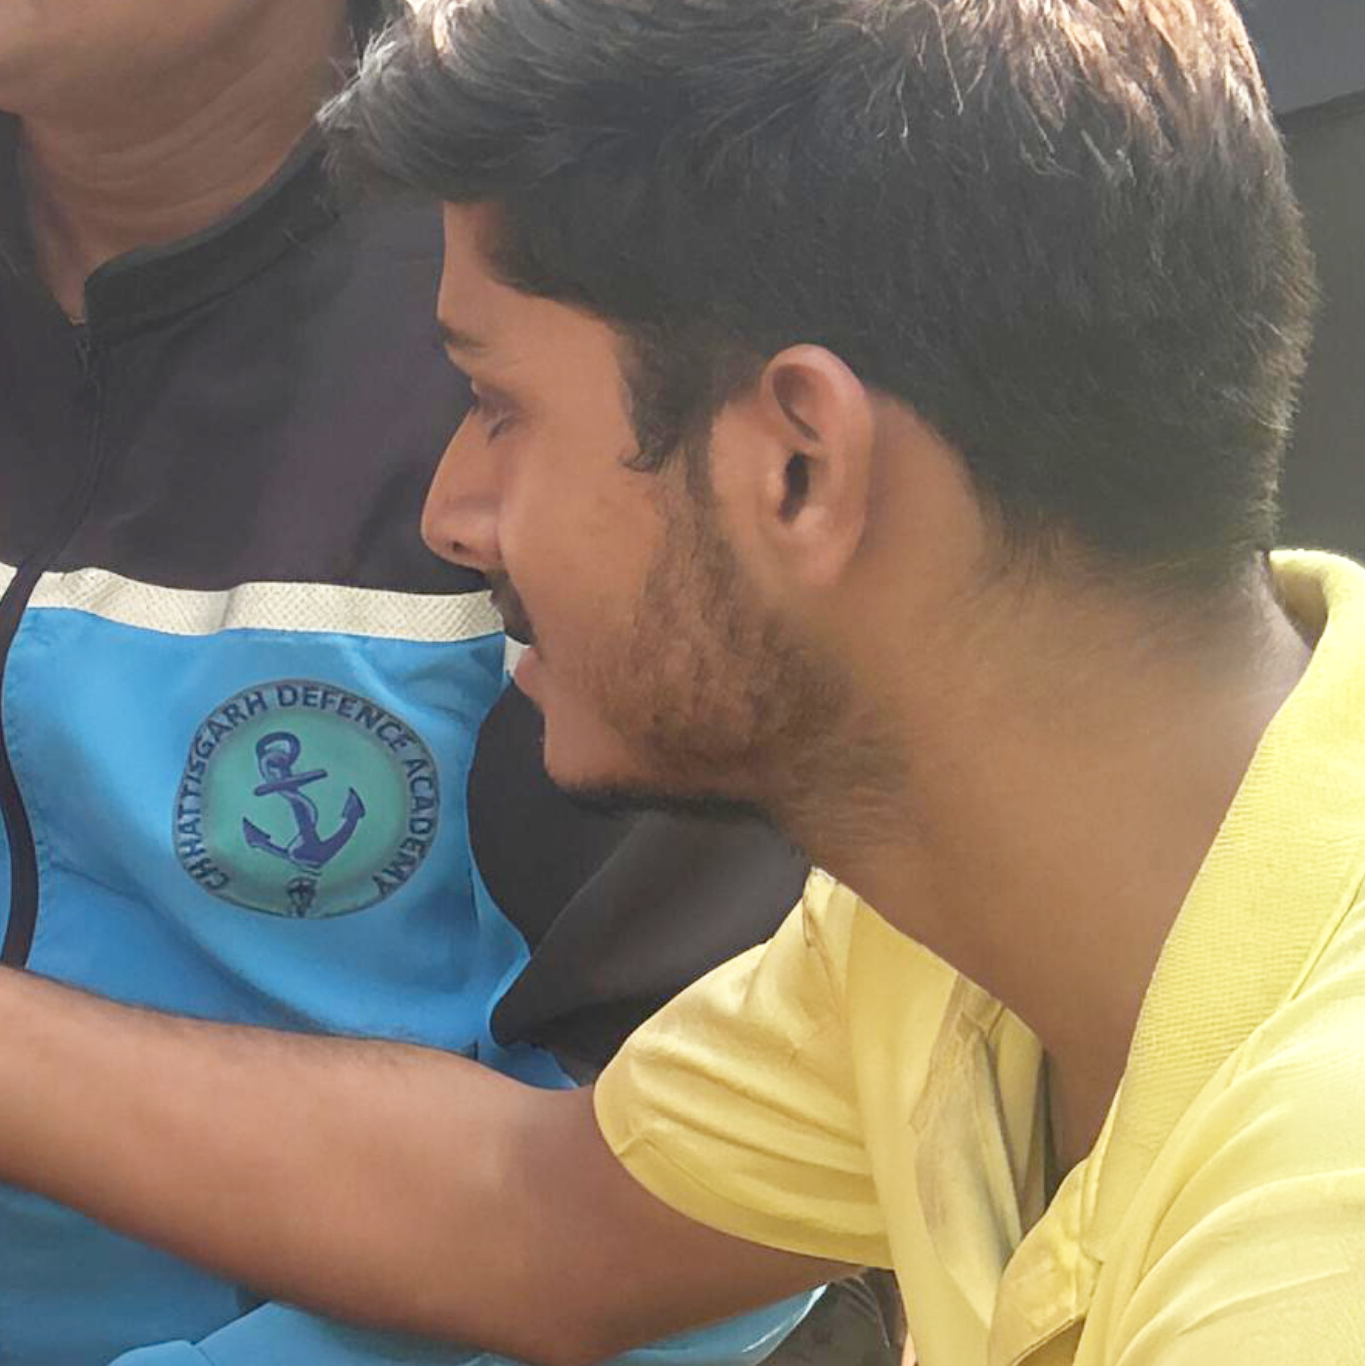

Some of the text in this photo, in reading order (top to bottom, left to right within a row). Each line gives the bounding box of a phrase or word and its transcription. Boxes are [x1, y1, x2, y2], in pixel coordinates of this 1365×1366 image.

[176, 684, 436, 896] CHHATTISGARH DEFENCE ACADEMY
